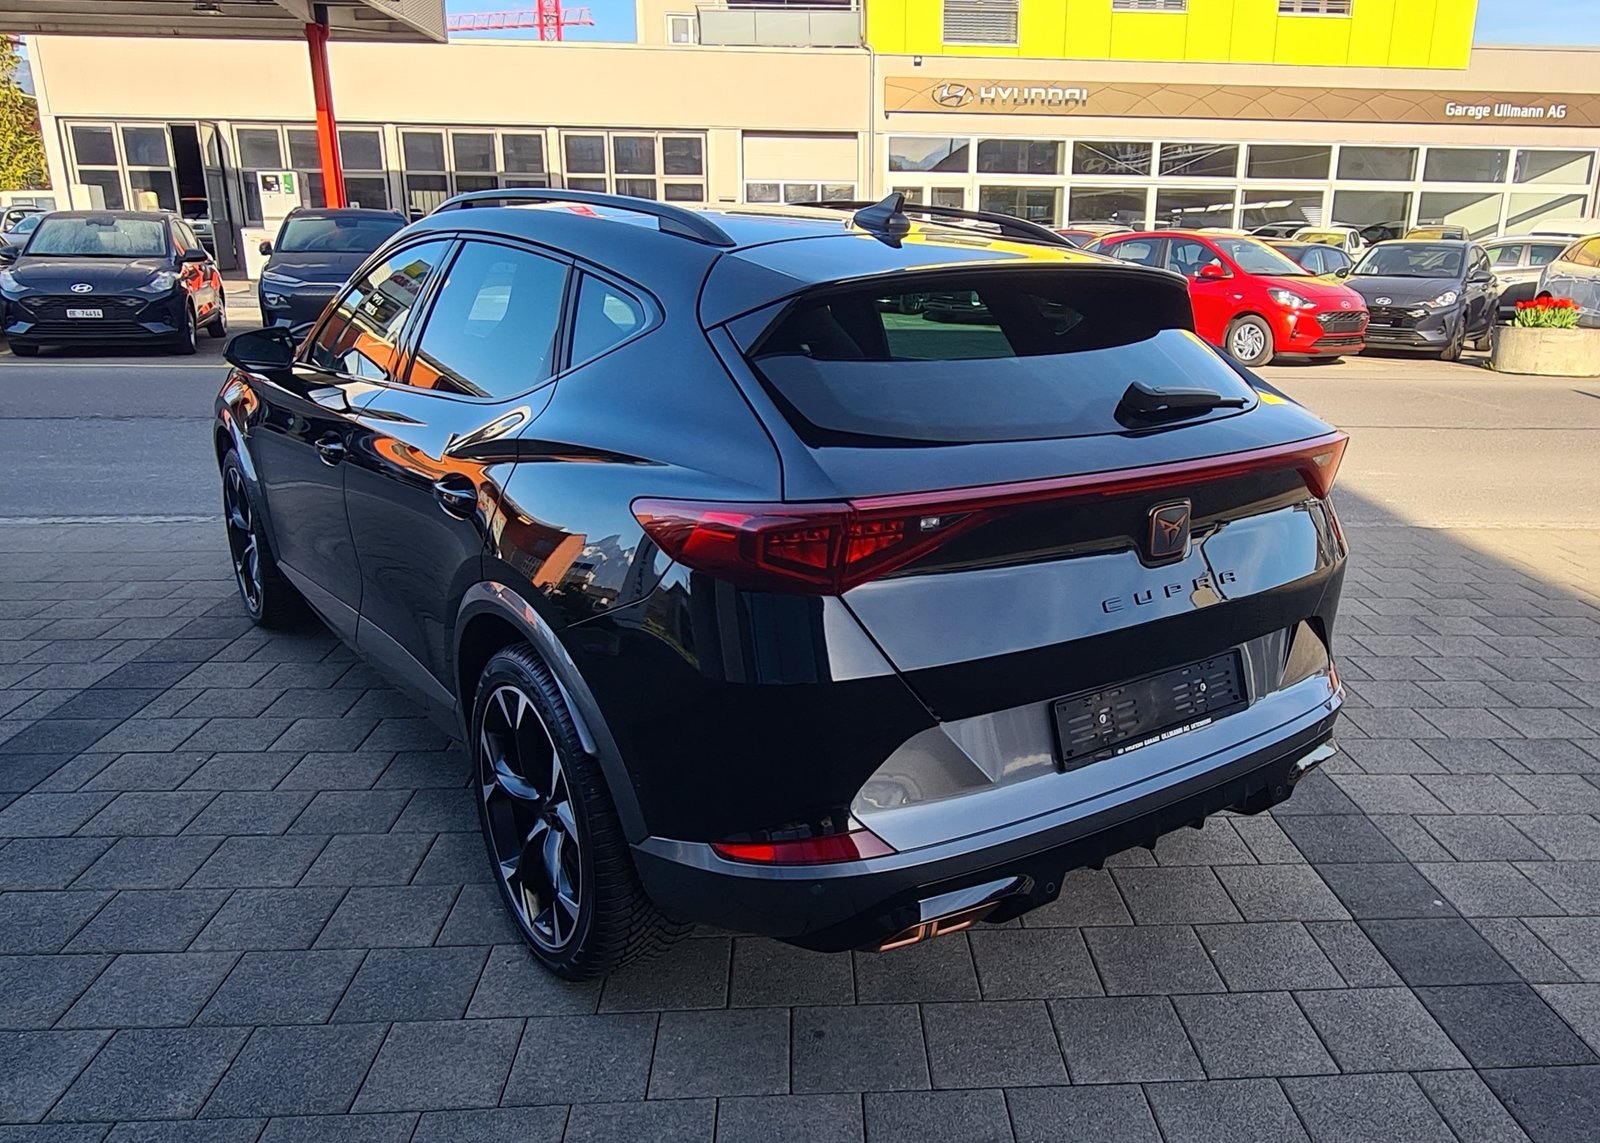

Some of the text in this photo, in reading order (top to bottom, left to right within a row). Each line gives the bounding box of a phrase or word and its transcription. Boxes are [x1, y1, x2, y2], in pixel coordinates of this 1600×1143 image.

[980, 86, 1088, 107] HYUNDAI
[1445, 102, 1567, 119] Garage Ullmann AG
[1102, 570, 1237, 614] CUPRA
